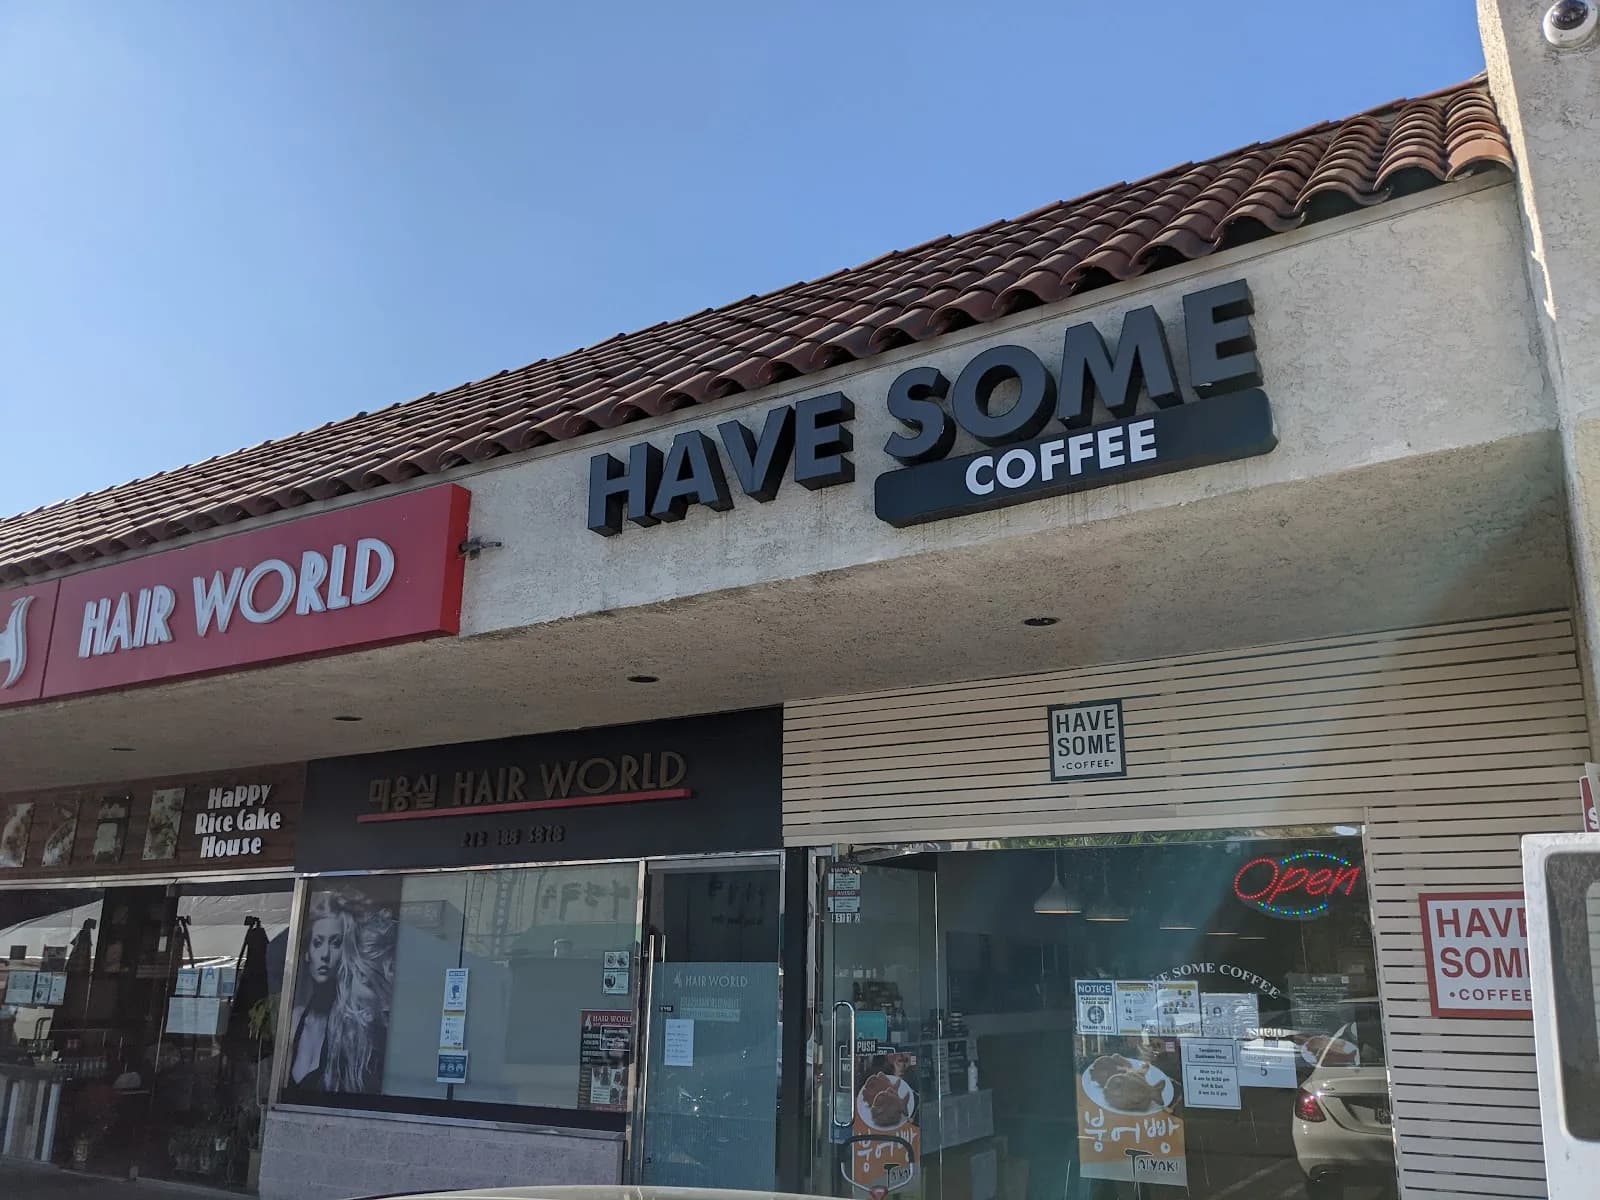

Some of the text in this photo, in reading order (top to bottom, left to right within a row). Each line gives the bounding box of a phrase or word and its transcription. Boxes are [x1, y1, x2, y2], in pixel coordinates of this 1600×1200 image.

[587, 278, 1264, 536] HAVE SOME
[965, 419, 1158, 496] COFFEE
[78, 537, 395, 658] HAIR WORLD
[1055, 709, 1115, 734] HAVE
[1057, 733, 1116, 757] SOME
[1065, 759, 1110, 770] COFFEE
[453, 767, 530, 806] HAIR
[540, 750, 688, 800] WORLD
[207, 784, 271, 809] Happy
[195, 808, 281, 834] Rice Cake
[200, 836, 262, 858] House
[1233, 858, 1360, 903] Open
[685, 974, 748, 988] HAIR WORLD
[1078, 984, 1112, 994] NOTICE
[1171, 961, 1217, 979] SOME
[1219, 963, 1282, 1000] COFFEE
[592, 1015, 609, 1023] HAIR
[857, 1040, 876, 1053] PUSH
[1260, 1065, 1268, 1077] 5
[1084, 1108, 1181, 1153] 붕어빵
